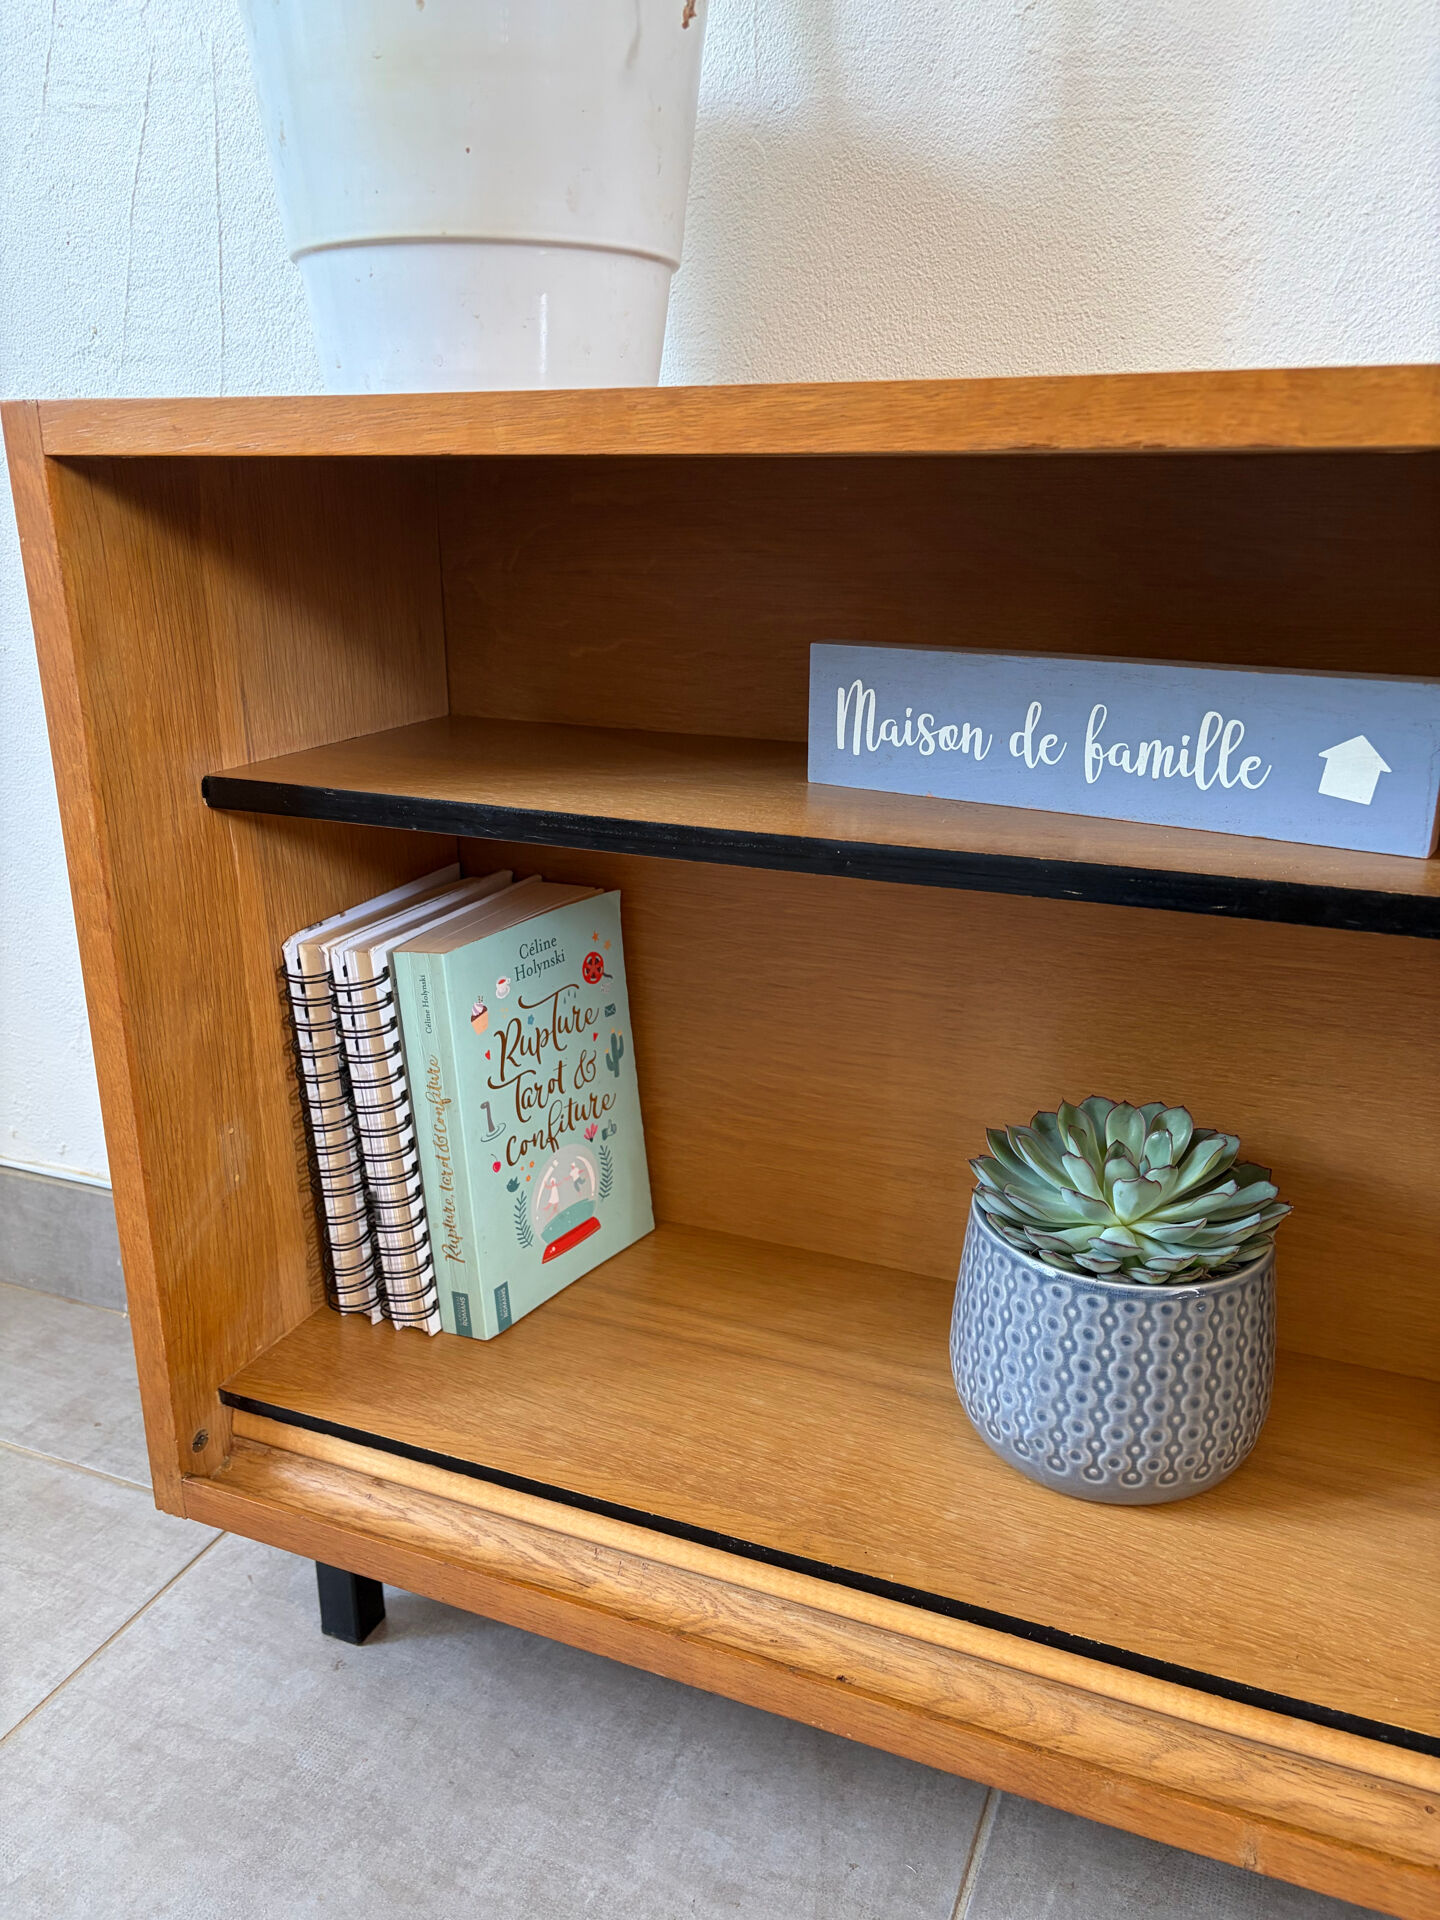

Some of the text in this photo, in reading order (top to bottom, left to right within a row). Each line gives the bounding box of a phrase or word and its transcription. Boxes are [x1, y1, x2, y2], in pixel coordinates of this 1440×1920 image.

[836, 679, 1273, 791] Maison de famille
[519, 936, 558, 960] Céline
[514, 950, 566, 982] Holynski
[418, 975, 433, 1034] Céline Holynski
[487, 1049, 598, 1123] Tarot &
[432, 1136, 449, 1153] &
[459, 1296, 470, 1327] ROMANS
